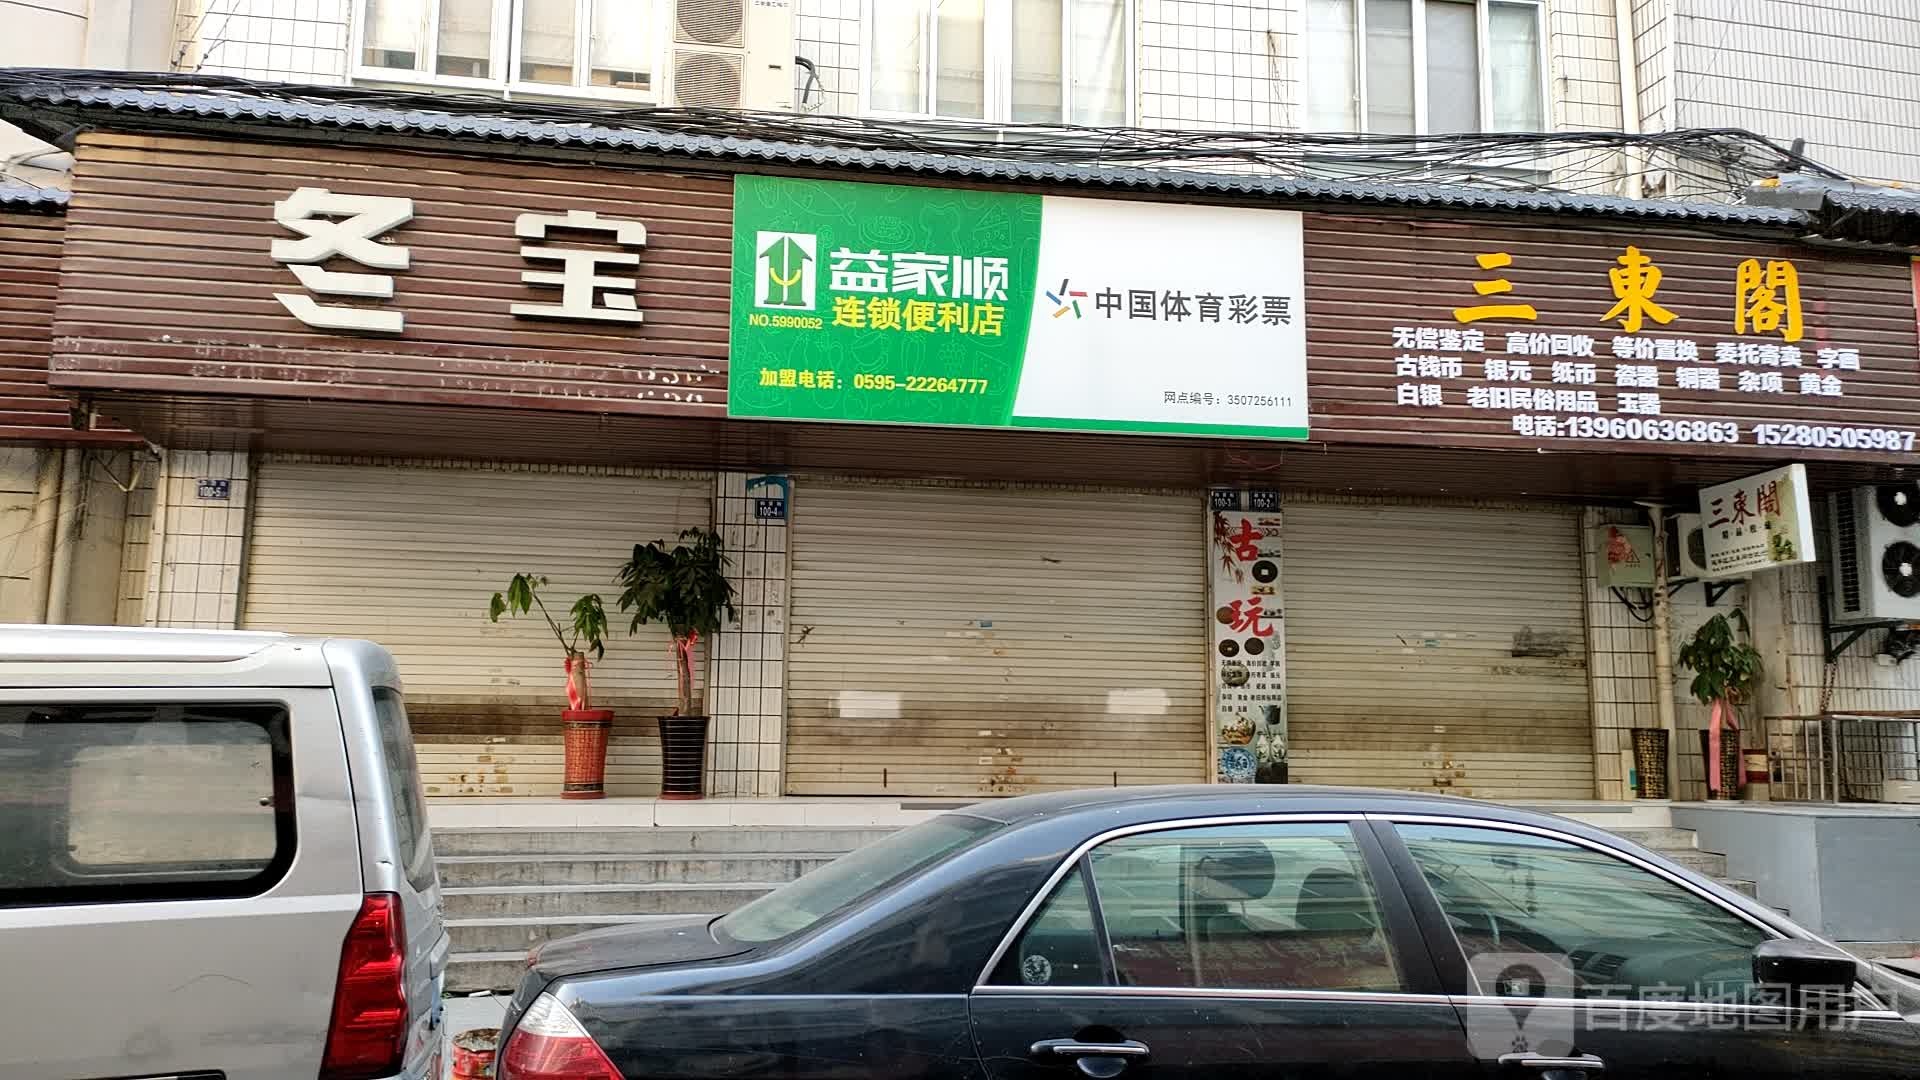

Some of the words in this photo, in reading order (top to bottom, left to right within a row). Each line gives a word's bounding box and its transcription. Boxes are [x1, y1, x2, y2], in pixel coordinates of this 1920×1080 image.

[271, 187, 647, 332] 冬宝
[829, 247, 1009, 300] 益家顺
[1095, 287, 1292, 326] 中国体育彩票
[1452, 246, 1804, 342] 三東閣
[749, 314, 823, 329] NO.5990052
[832, 296, 1005, 336] 连锁便利店
[1392, 327, 1485, 352] 无偿鉴定
[1505, 332, 1595, 358] 高价回收
[1612, 336, 1699, 362] 等价置换
[1715, 342, 1802, 368] 委托寄卖
[1816, 347, 1860, 370] 字画
[1394, 354, 1463, 379] 古钱币
[1484, 358, 1532, 383] 银元
[1551, 361, 1597, 385] 纸币
[1614, 364, 1659, 388] 瓷器
[1676, 366, 1721, 391] 铜器
[1738, 370, 1783, 393] 杂项
[1799, 372, 1843, 396] 黄金
[1397, 383, 1444, 407] 白银
[1467, 386, 1599, 414] 老旧民俗用品
[1616, 392, 1661, 415] 玉器
[1512, 414, 1739, 443] 电话:13960636863
[1751, 423, 1916, 450] 15280505987
[1708, 480, 1781, 528] 三東閣
[1229, 518, 1274, 637] 古玩
